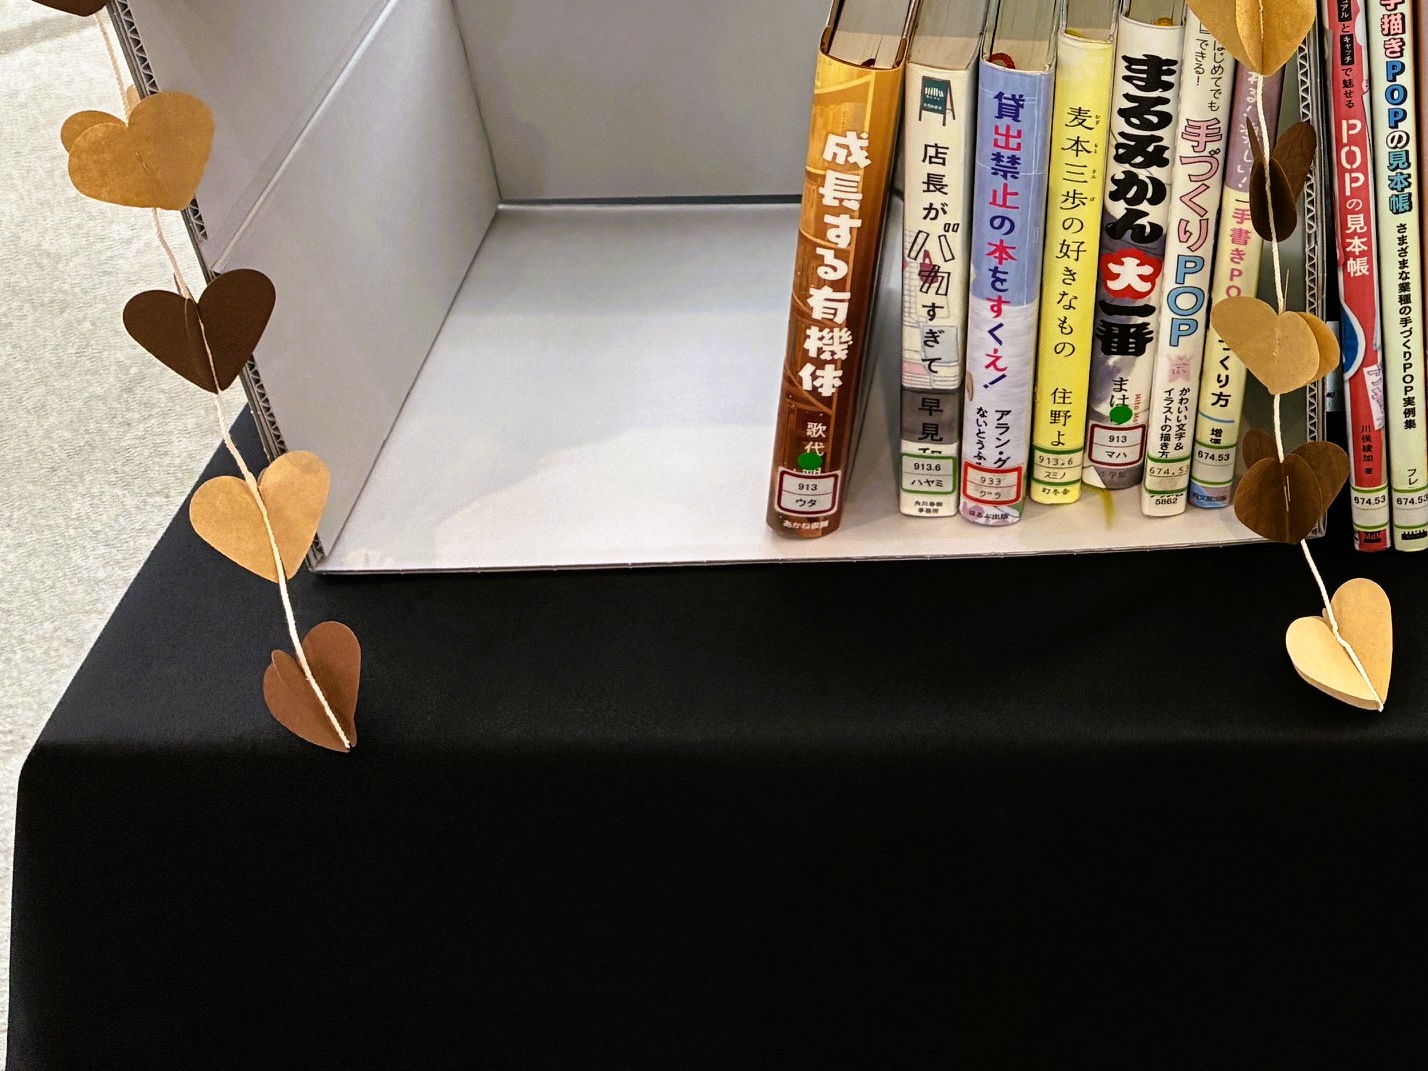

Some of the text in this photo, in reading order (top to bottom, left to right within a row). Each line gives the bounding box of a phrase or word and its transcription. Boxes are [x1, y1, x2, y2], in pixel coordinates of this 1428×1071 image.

[1339, 118, 1370, 278] POPの見本帳
[1095, 53, 1179, 357] まるみかん大一番
[1053, 107, 1094, 358] 麦本三歩の好きなもの
[1167, 117, 1223, 347] 手づくりPOP
[982, 91, 1026, 390] 貸出禁止の本をすくえ！
[799, 130, 872, 397] 成長する有機体
[908, 143, 960, 375] 店長がバカすぎて
[916, 397, 944, 455] 早見
[1108, 434, 1128, 443] 913
[1038, 455, 1074, 467] 913.6
[1105, 450, 1127, 460] マハ
[1197, 451, 1230, 462] 674.53
[913, 462, 942, 472] 913.6
[911, 478, 944, 489] ハヤミ
[980, 475, 1002, 486] 933
[798, 482, 818, 492] 913
[795, 498, 818, 508] ウタ
[1354, 494, 1387, 506] 674.53
[1396, 494, 1428, 506] 674.53
